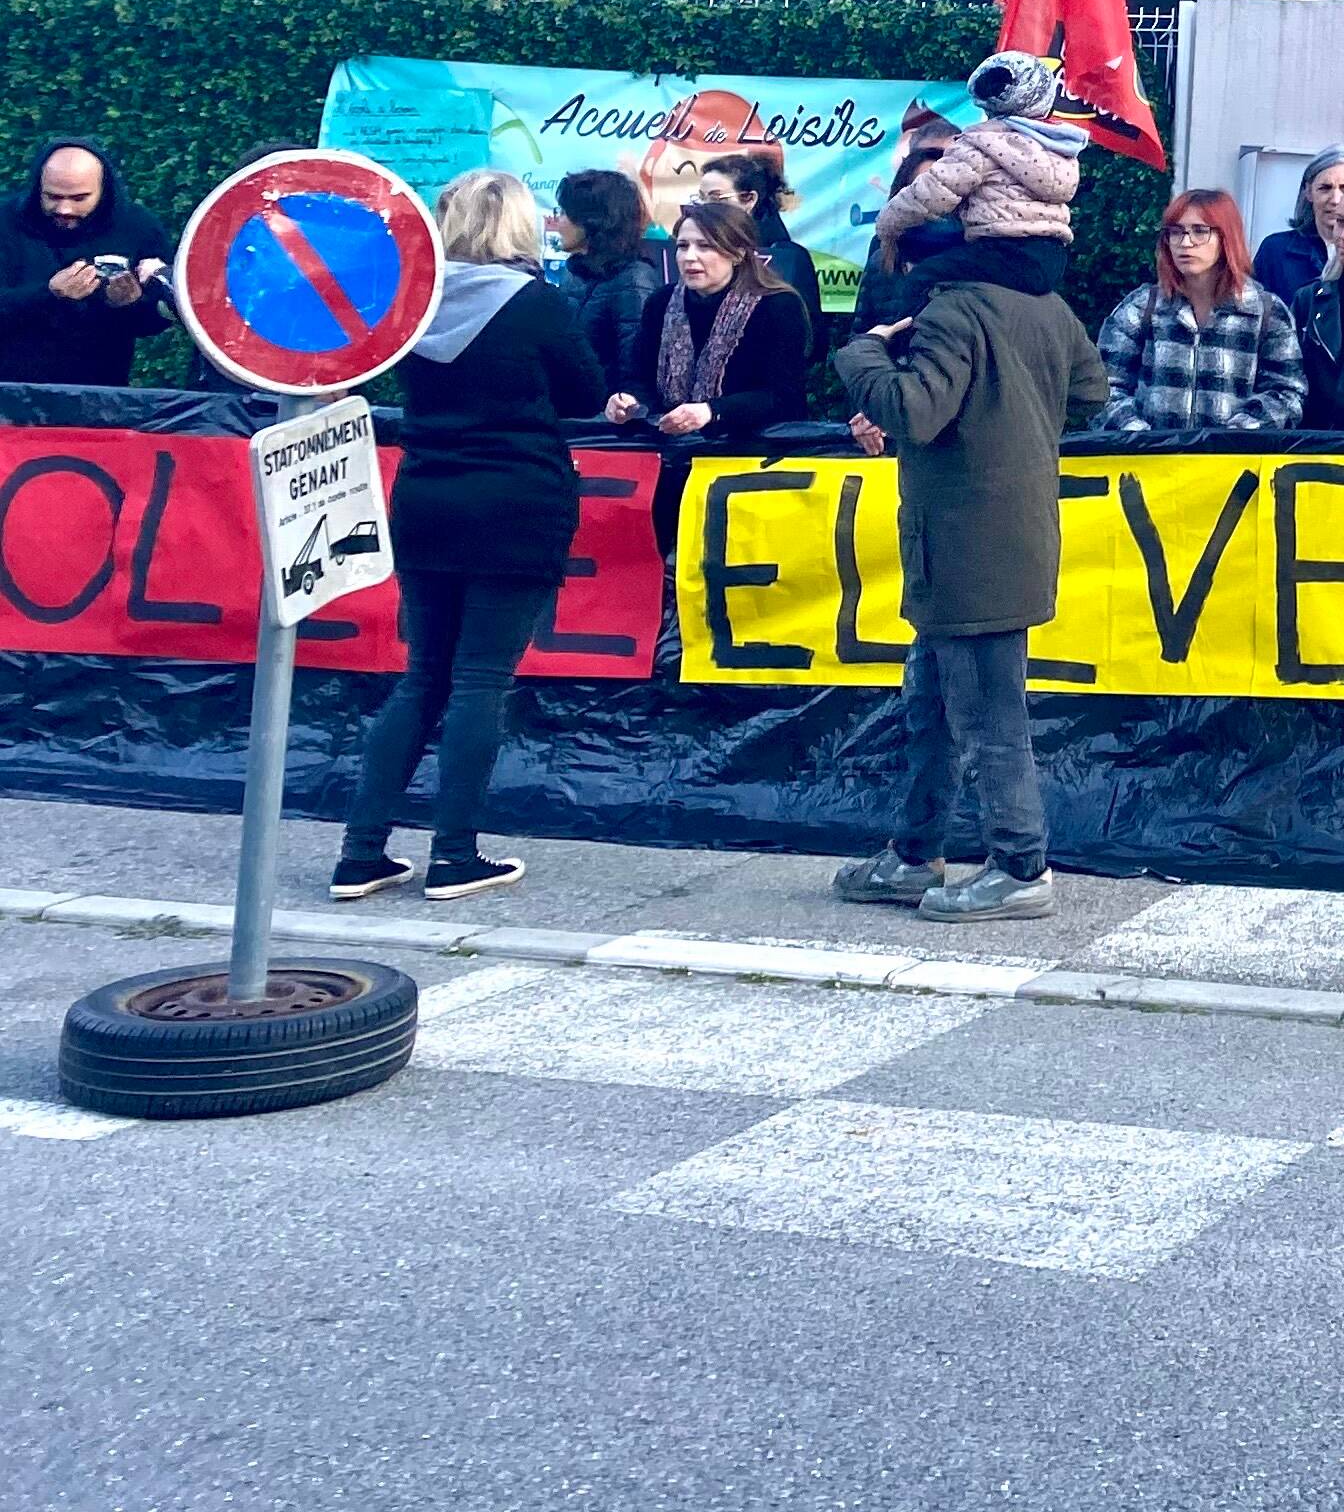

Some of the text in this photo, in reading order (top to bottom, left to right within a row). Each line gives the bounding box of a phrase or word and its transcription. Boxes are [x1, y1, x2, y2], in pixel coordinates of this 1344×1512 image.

[540, 92, 887, 150] Accueil de Loisirs
